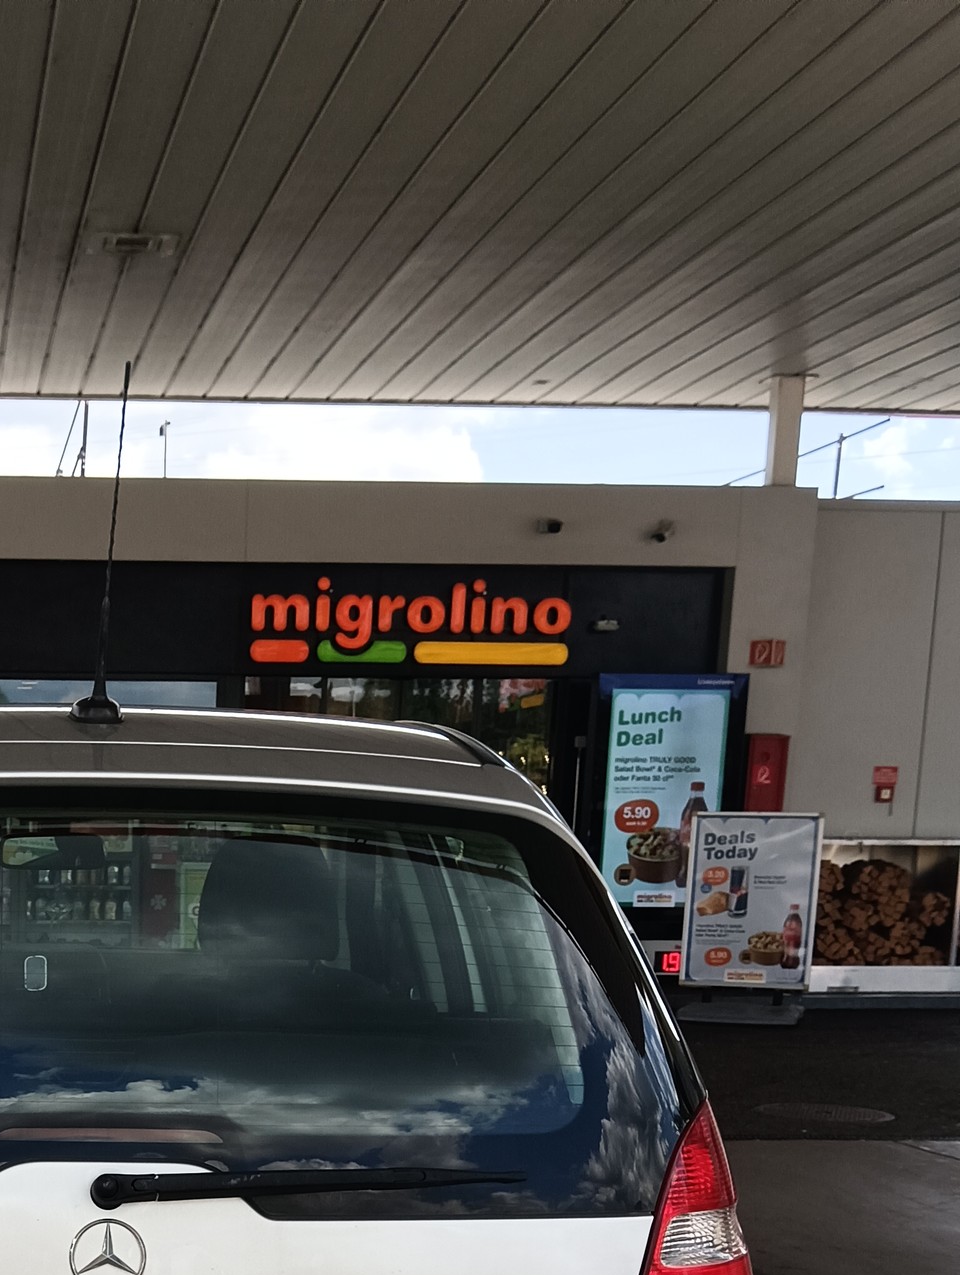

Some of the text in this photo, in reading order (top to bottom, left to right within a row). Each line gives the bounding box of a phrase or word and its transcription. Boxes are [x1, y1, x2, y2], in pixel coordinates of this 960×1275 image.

[251, 576, 572, 650] migrolino
[618, 706, 682, 726] Lunch
[616, 728, 663, 747] Deal
[623, 806, 651, 819] 5.90
[704, 831, 756, 846] Deals
[703, 846, 758, 860] Today
